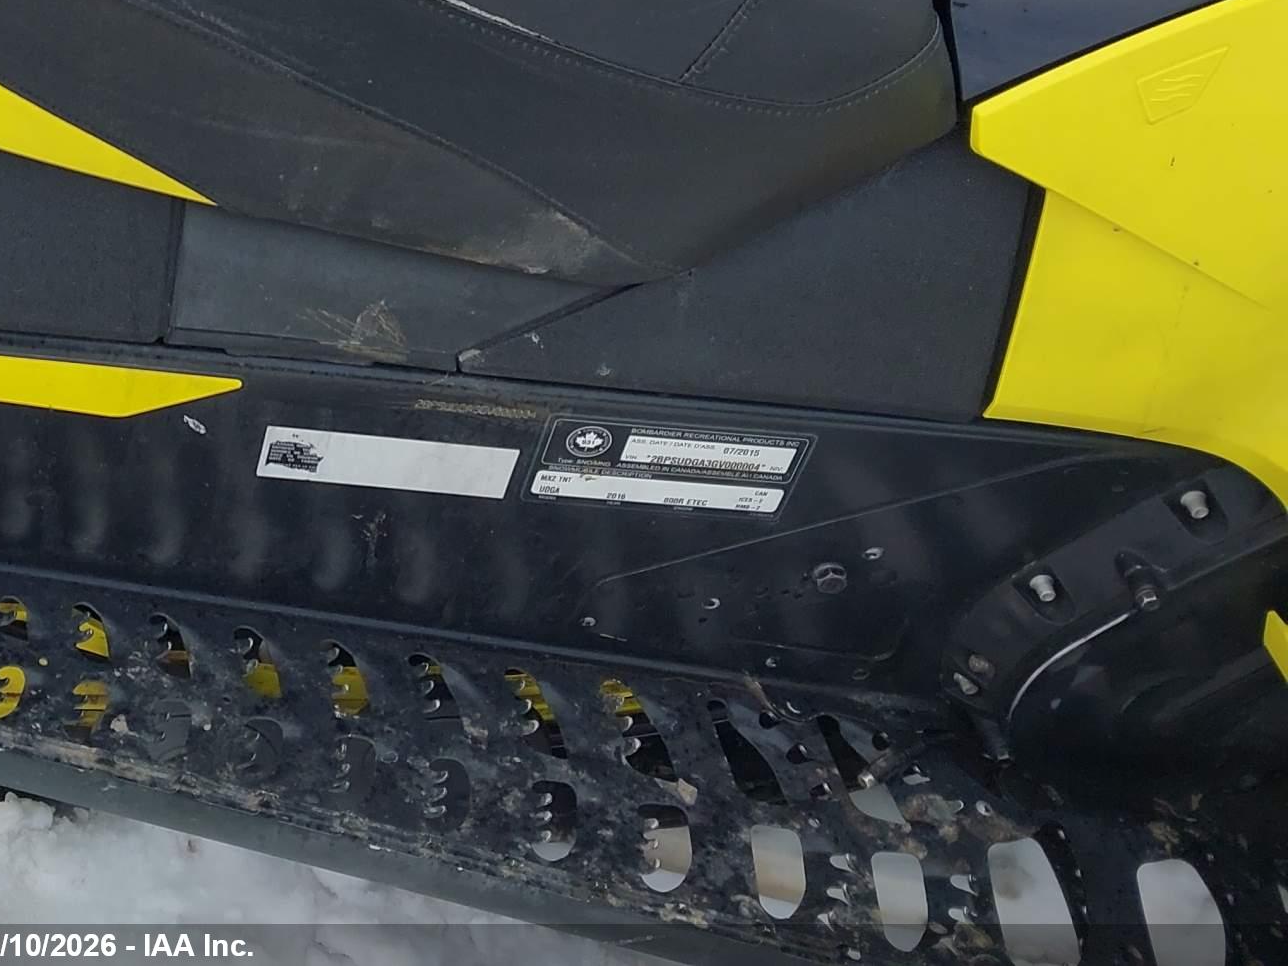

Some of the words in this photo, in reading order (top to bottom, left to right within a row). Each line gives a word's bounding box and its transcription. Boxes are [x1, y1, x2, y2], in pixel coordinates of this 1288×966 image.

[631, 427, 682, 438] BOMBARDIER
[683, 432, 741, 443] RECREATIONAL
[742, 437, 785, 446] PRODUCTS
[723, 447, 761, 457] 07/2015
[616, 462, 661, 471] ASSEMBLED
[606, 492, 626, 500] 2016
